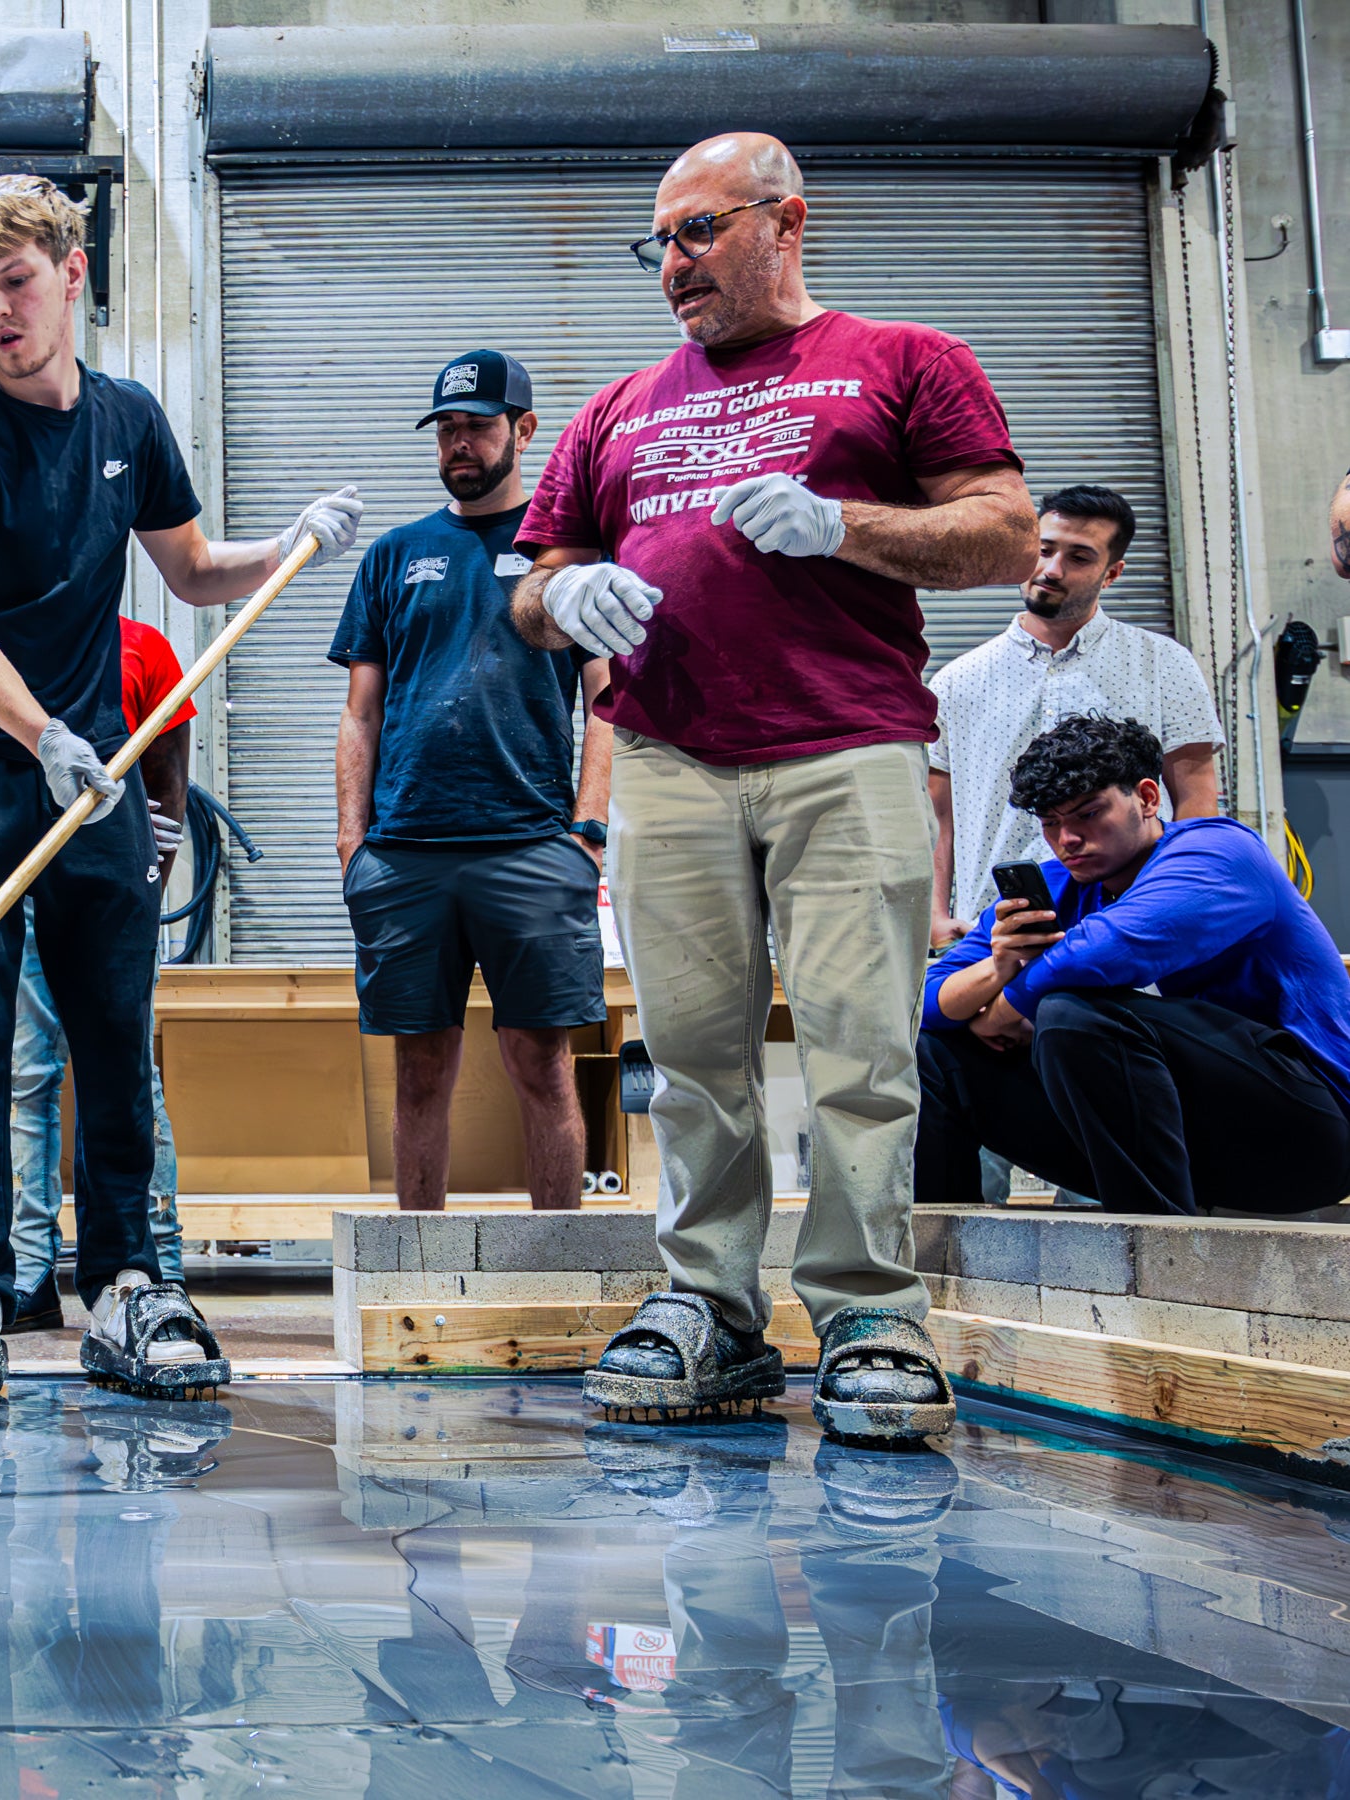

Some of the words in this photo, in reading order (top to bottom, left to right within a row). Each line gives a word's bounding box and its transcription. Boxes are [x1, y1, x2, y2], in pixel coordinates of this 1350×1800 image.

[684, 381, 758, 402] PROPERTY
[765, 376, 785, 387] OF
[610, 401, 722, 441] POLISHED
[727, 379, 863, 415] CONCRETE
[658, 422, 741, 439] ATHLETIC
[744, 407, 791, 430] DEPT.
[645, 452, 668, 463] EST.
[682, 438, 755, 465] XXL
[772, 430, 800, 443] 2016
[747, 462, 761, 472] FL
